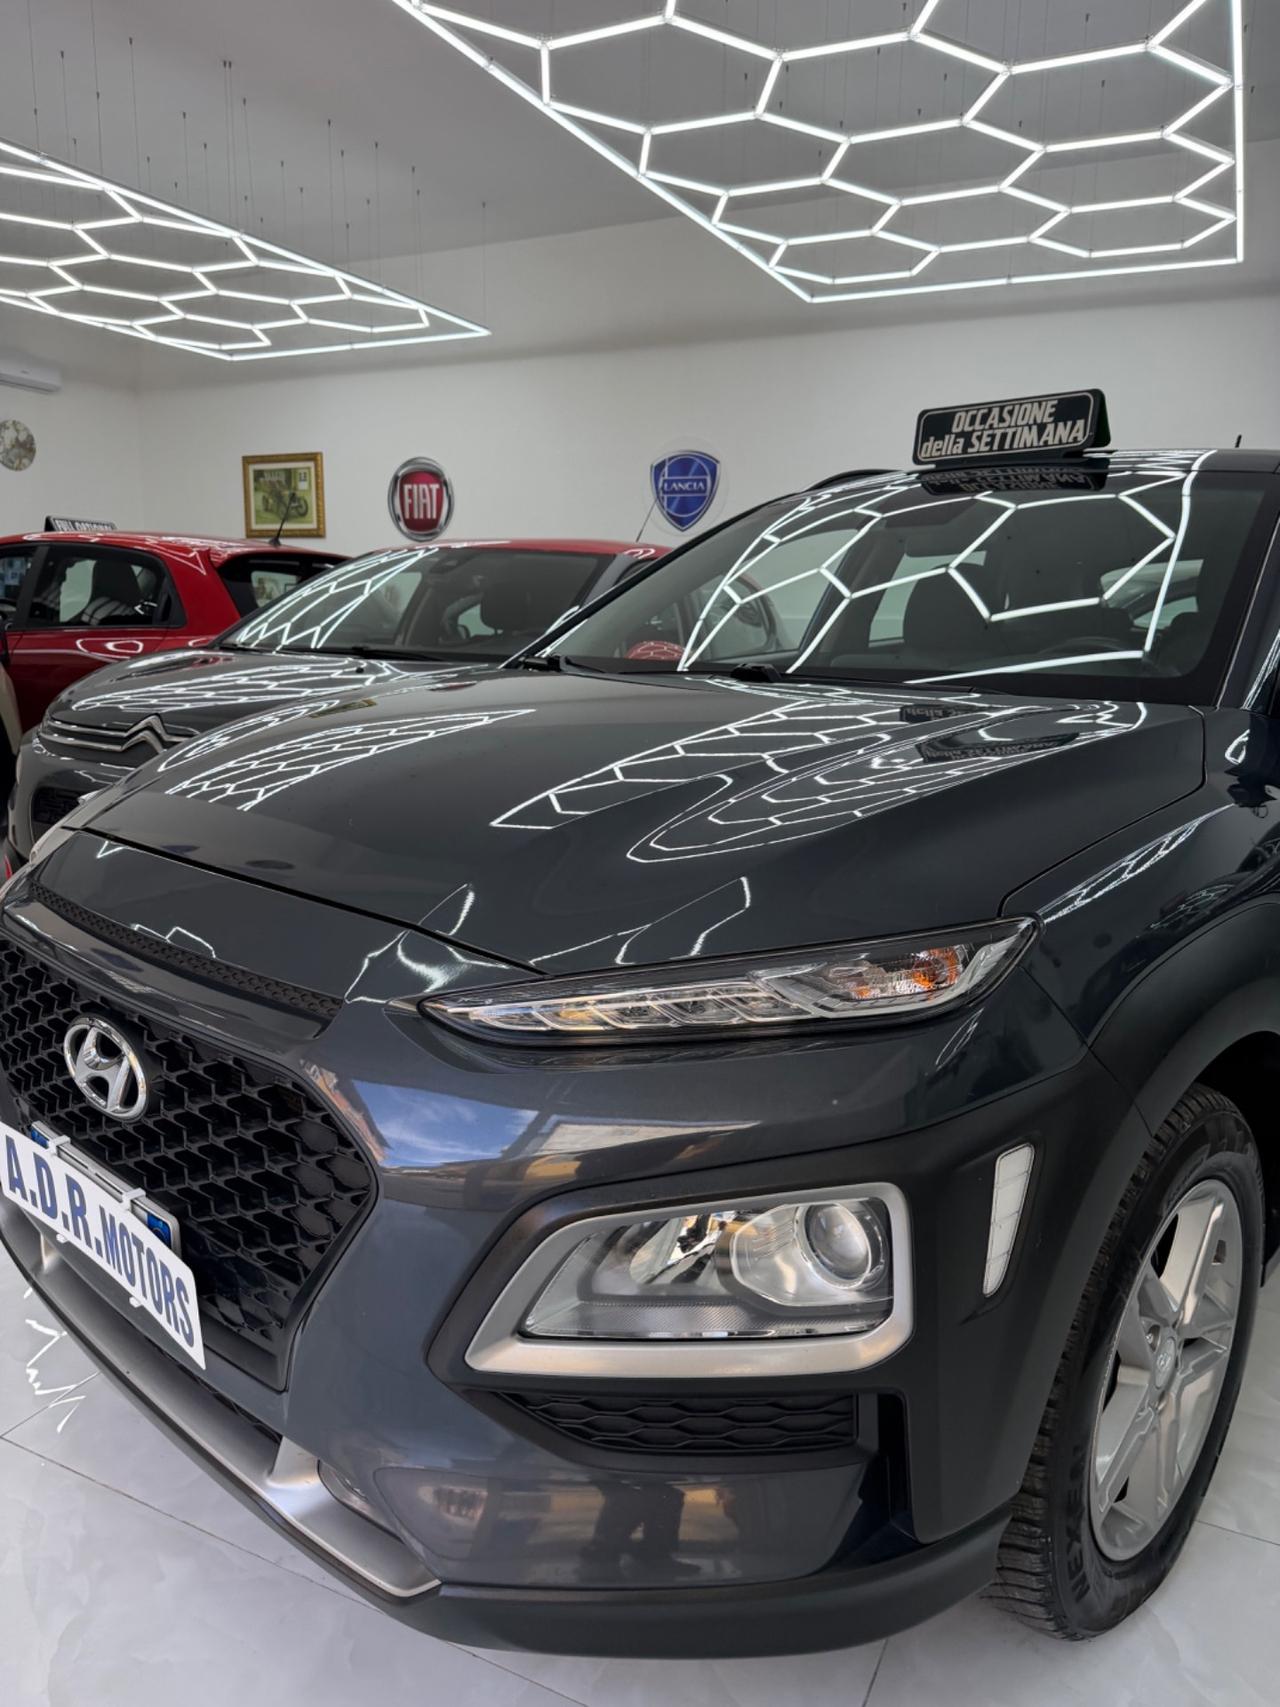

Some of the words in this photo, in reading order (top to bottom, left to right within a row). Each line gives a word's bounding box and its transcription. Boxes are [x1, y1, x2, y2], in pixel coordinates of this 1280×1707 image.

[952, 400, 1058, 433] OCCASIONE
[921, 434, 964, 458] della
[967, 419, 1085, 453] SETTIMANA
[403, 483, 440, 519] FIAT
[663, 480, 706, 492] LANCIA
